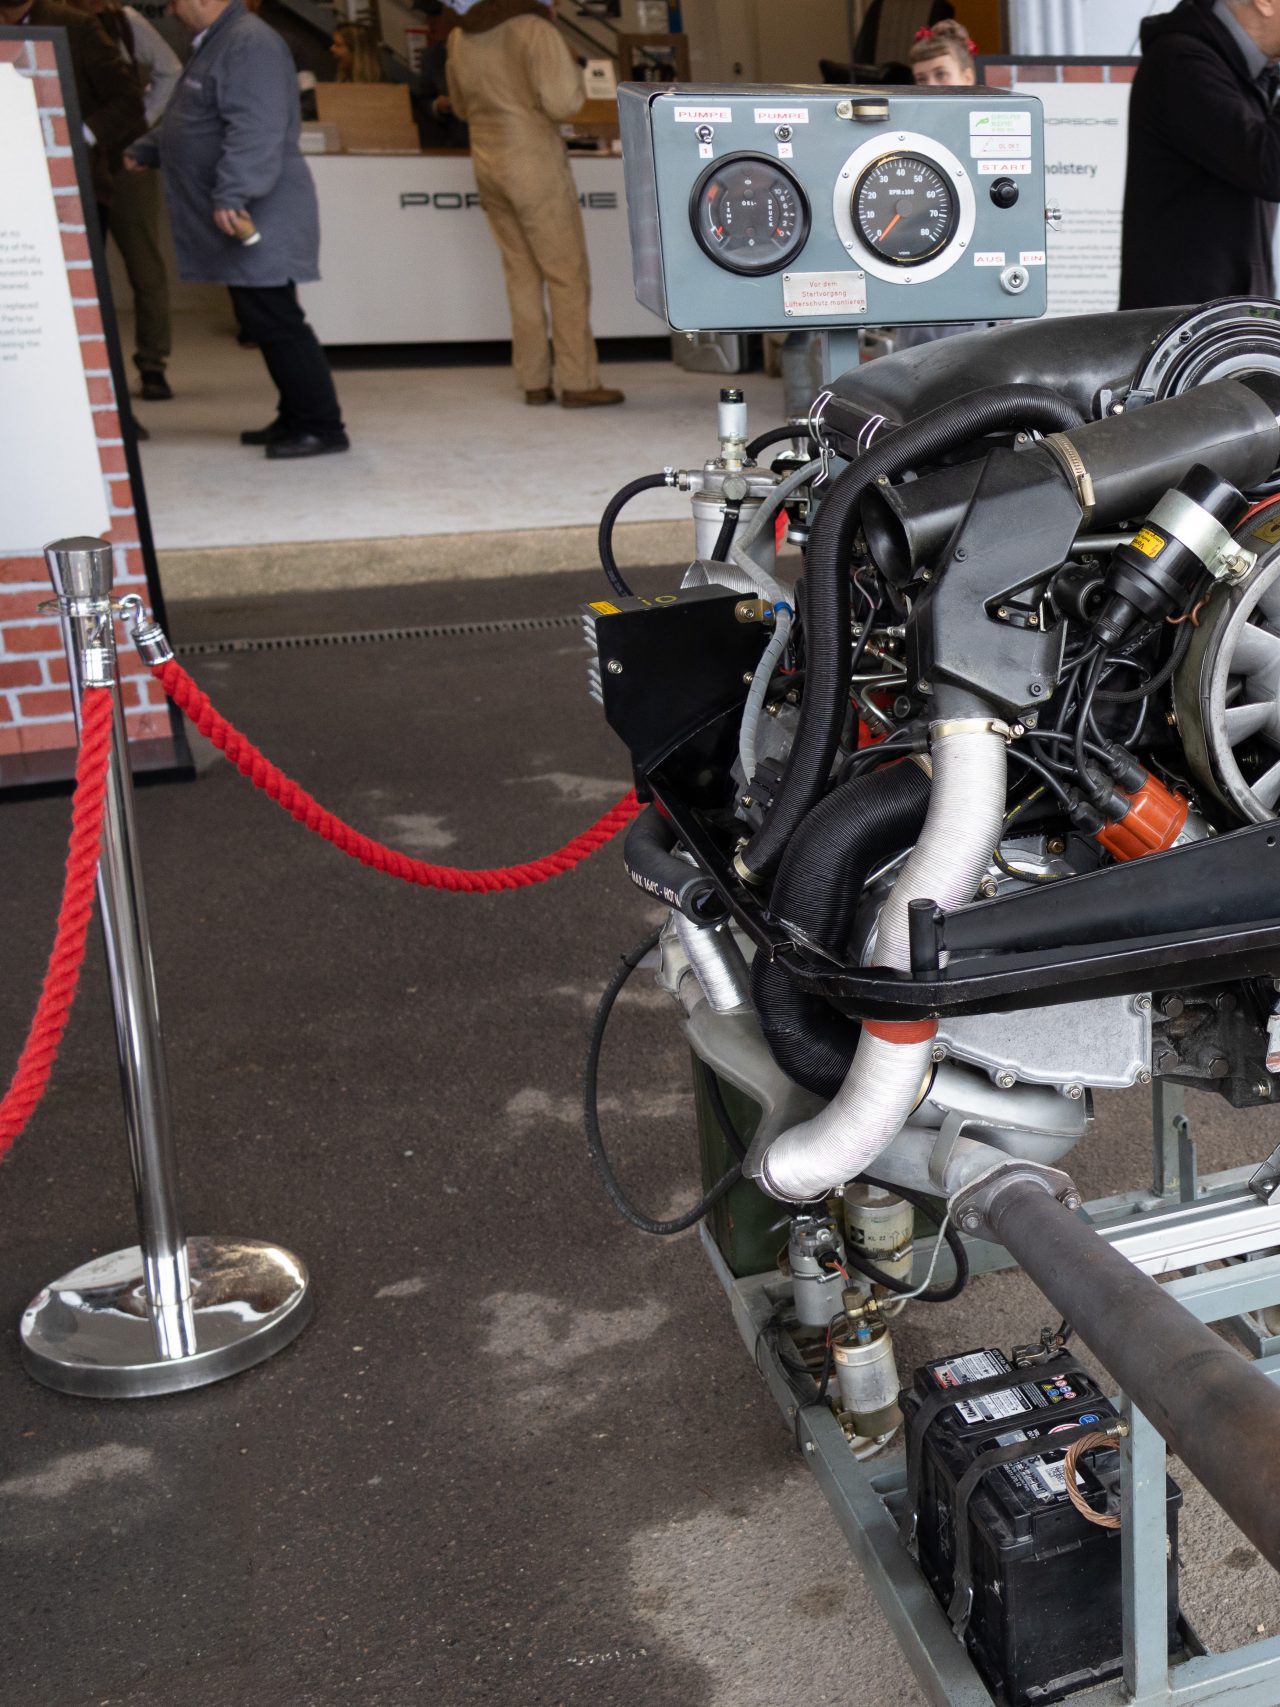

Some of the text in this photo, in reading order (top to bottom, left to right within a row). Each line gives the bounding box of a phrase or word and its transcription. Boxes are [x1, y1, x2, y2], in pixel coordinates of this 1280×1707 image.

[678, 111, 729, 119] PUMPE
[757, 112, 807, 120] PUMPE
[1043, 118, 1119, 126] ORSCHE
[896, 168, 906, 176] 40
[879, 175, 889, 183] 30
[914, 175, 923, 183] 50
[867, 191, 877, 199] 20
[926, 190, 936, 199] 60
[866, 211, 876, 219] 10
[929, 209, 939, 217] 70
[876, 229, 882, 237] 0
[920, 228, 930, 236] 80
[801, 290, 848, 298] Startvorgang
[631, 869, 644, 888] MAX
[663, 886, 675, 904] HOT
